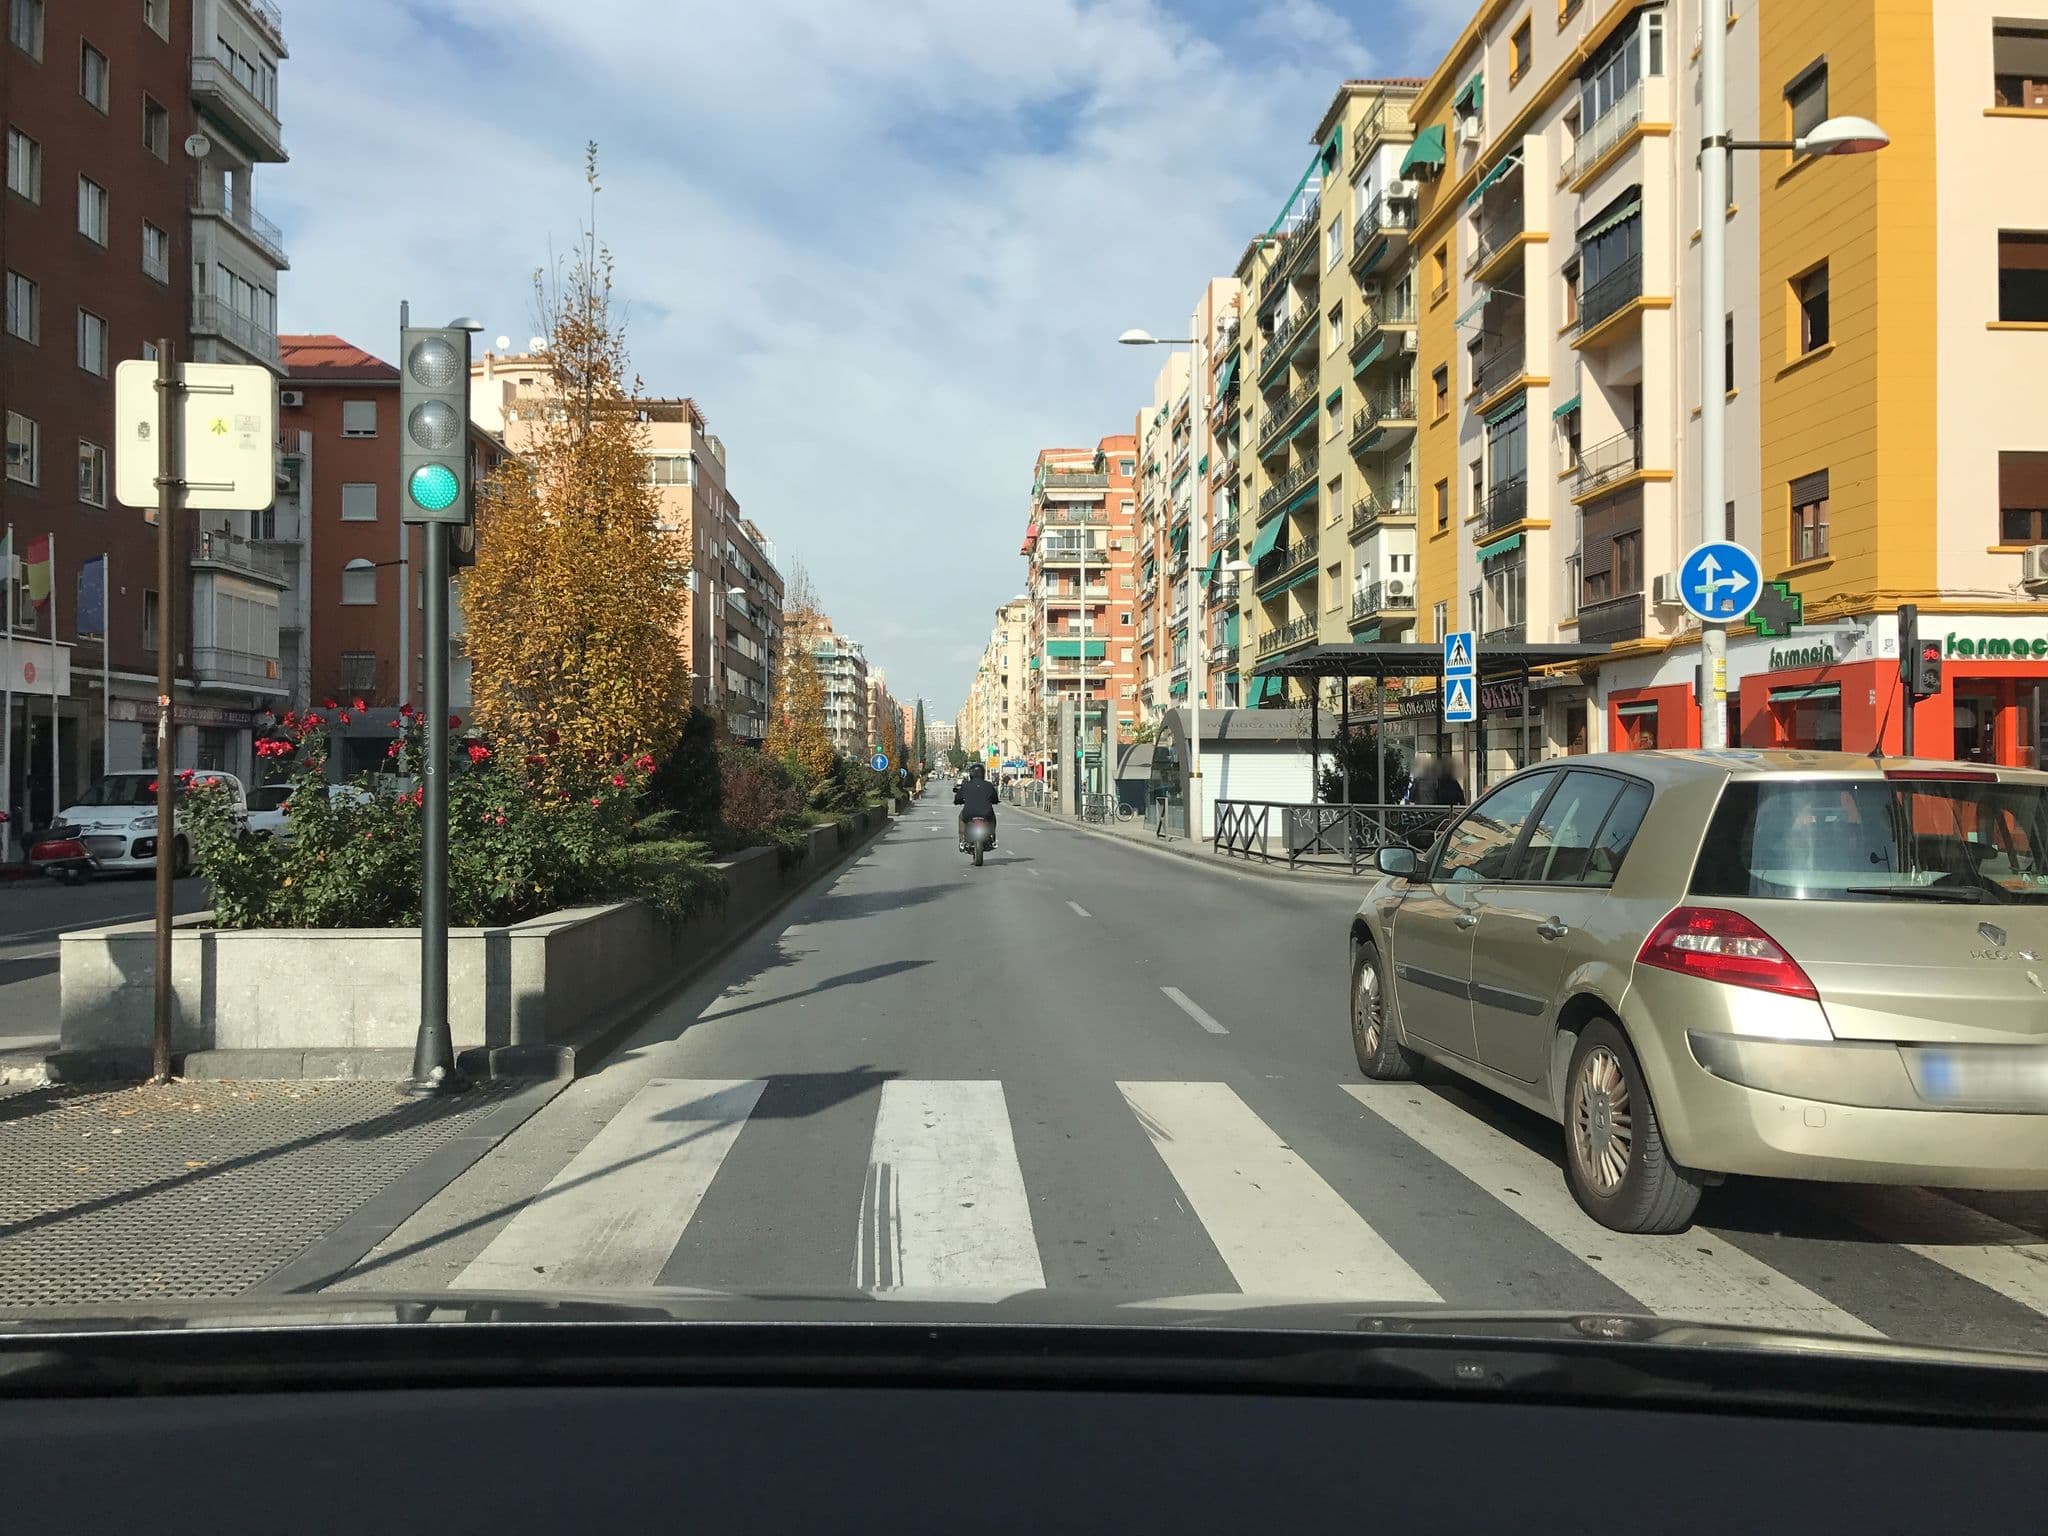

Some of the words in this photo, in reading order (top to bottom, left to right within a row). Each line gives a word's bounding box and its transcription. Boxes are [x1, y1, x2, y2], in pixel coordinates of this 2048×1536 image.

[1770, 640, 1834, 668] farmacia
[1947, 632, 2047, 655] farmac
[1481, 684, 1520, 709] OKER
